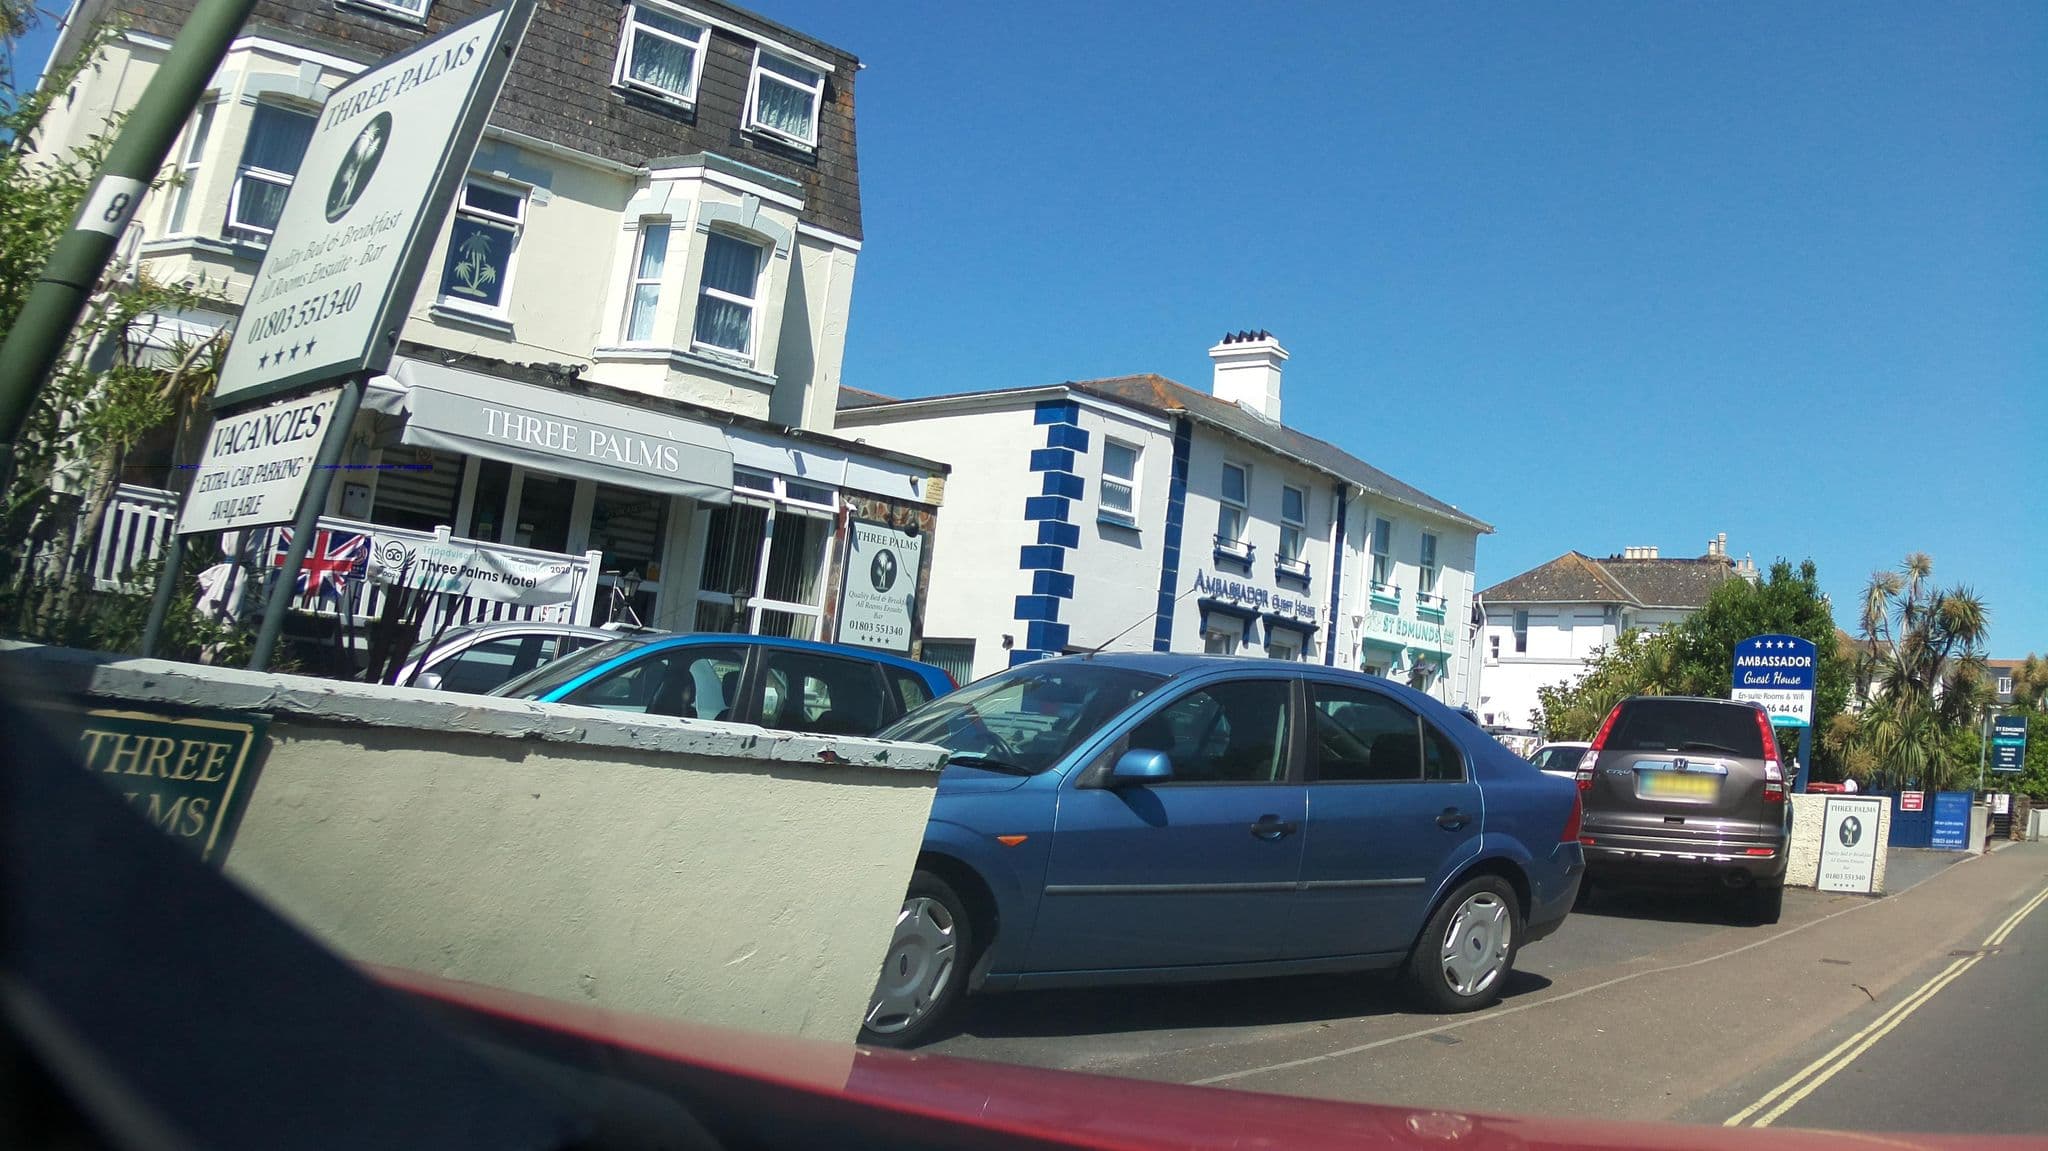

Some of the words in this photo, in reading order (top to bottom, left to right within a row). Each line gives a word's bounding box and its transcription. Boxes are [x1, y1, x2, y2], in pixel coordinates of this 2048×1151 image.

[323, 76, 396, 132] THREE
[395, 36, 480, 97] PALMS
[103, 192, 130, 223] 8
[303, 234, 330, 262] Bed
[340, 209, 403, 248] Breakfast
[272, 272, 309, 298] Rooms
[308, 256, 352, 284] Ensuite
[359, 241, 388, 267] Bar
[248, 304, 296, 345] 01803
[294, 282, 362, 329] 551340
[212, 402, 326, 458] VACANCIES
[481, 407, 579, 453] THREE
[588, 429, 680, 473] PALMS
[198, 471, 231, 494] EXTRA
[231, 465, 254, 487] CAR
[253, 456, 304, 485] PARKING
[209, 494, 265, 521] AVAILABLE
[857, 530, 888, 546] THREE
[888, 537, 919, 551] PALMS
[420, 558, 458, 575] Three
[460, 565, 499, 583] Palms
[501, 572, 537, 589] Hotel
[849, 590, 869, 600] Quality
[865, 601, 883, 610] Rooms
[849, 620, 874, 632] 01803
[875, 623, 904, 636] 551340
[1396, 617, 1440, 643] EDMUNDS
[1736, 655, 1811, 667] AMBASSADOR
[1744, 670, 1770, 685] Guest
[1773, 671, 1801, 685] House
[1764, 692, 1784, 700] Rooms
[1779, 704, 1790, 713] 44
[1792, 704, 1803, 713] 64
[80, 729, 233, 783] THREE
[1831, 804, 1853, 813] THREE
[1854, 805, 1877, 813] PALMS
